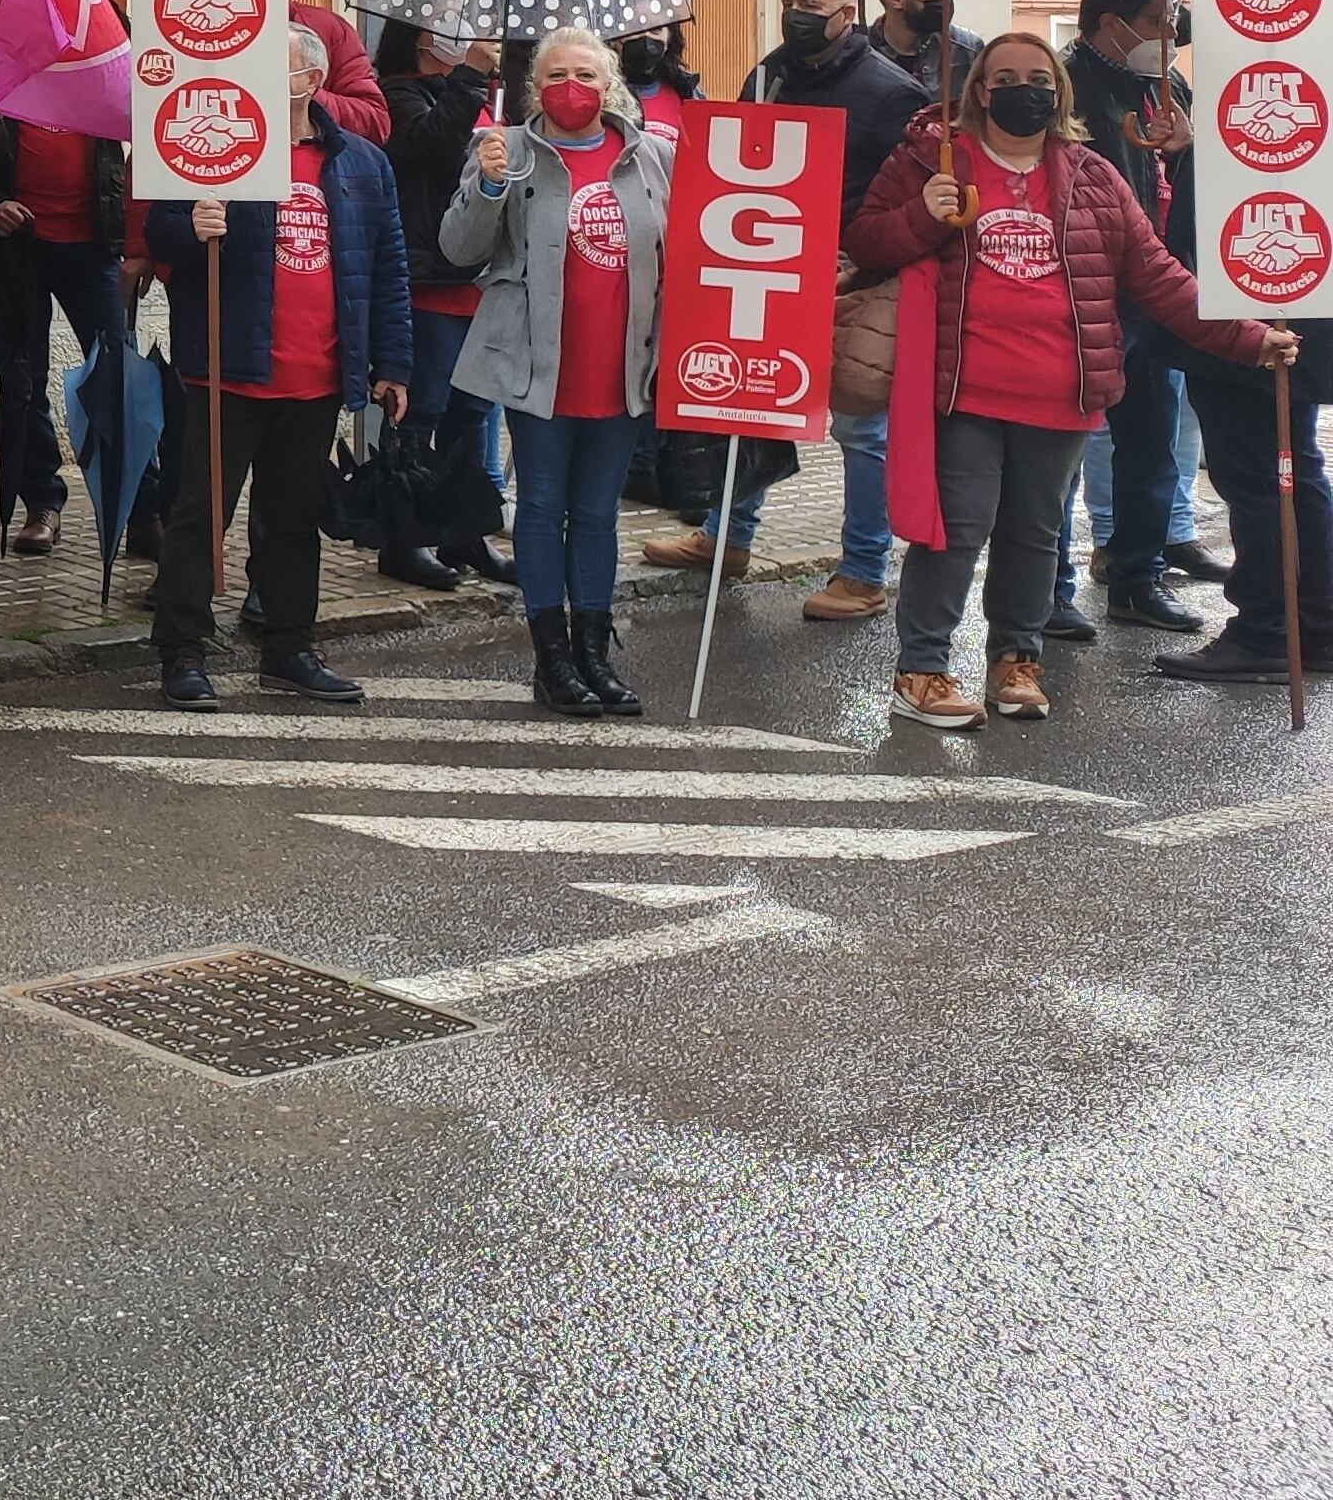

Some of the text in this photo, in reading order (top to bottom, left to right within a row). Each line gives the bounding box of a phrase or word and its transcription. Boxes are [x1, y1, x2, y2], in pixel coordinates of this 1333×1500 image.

[1228, 7, 1310, 35] Andalucía
[171, 27, 252, 53] Andalucía
[141, 53, 173, 71] UGT
[1238, 72, 1304, 104] UGT
[175, 88, 242, 121] UGT
[1234, 137, 1315, 165] Andalucía
[171, 153, 252, 179] Andalucía
[583, 205, 622, 222] DOCE
[1241, 202, 1308, 235] UGT
[585, 221, 624, 237] ESENCI
[699, 115, 809, 342] UGT
[981, 234, 1051, 249] DOCENTES
[1236, 269, 1318, 296] Andalucía
[688, 351, 733, 377] UGT
[746, 357, 782, 377] FSP
[717, 409, 767, 422] Andalucía
